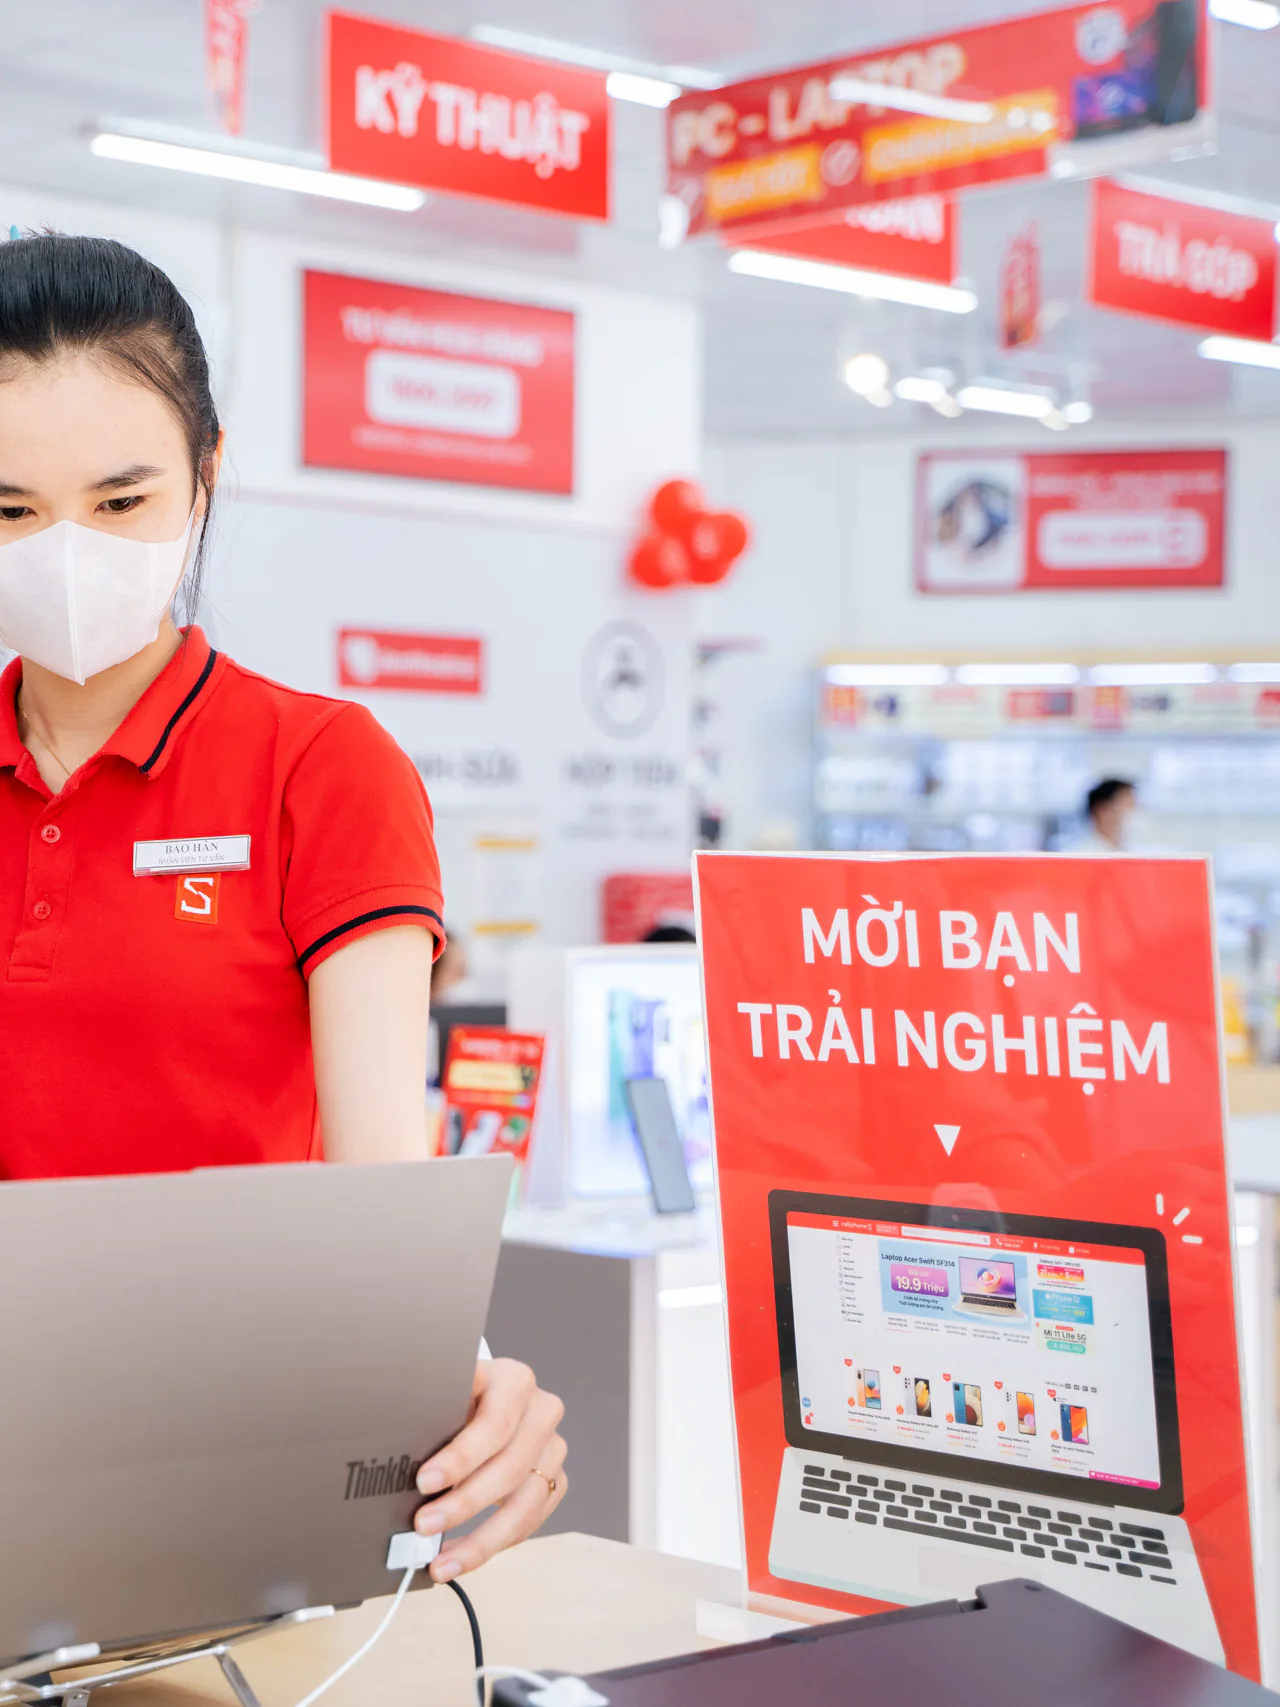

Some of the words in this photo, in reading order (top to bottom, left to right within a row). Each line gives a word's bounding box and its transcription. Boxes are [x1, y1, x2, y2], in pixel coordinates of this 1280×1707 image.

[354, 62, 423, 137] KỸ
[428, 80, 589, 179] THUẬT
[801, 894, 920, 967] MỜI
[939, 910, 1081, 987] BẠN
[737, 989, 876, 1066] TRẢI
[894, 1002, 1171, 1096] NGHIỆM
[881, 1253, 903, 1262] Laptop
[919, 1257, 936, 1265] Swift
[936, 1259, 955, 1267] SF314
[895, 1276, 921, 1291] 19.9
[923, 1282, 944, 1293] Triệu
[1062, 1331, 1075, 1339] Lite
[1077, 1333, 1086, 1341] 5G
